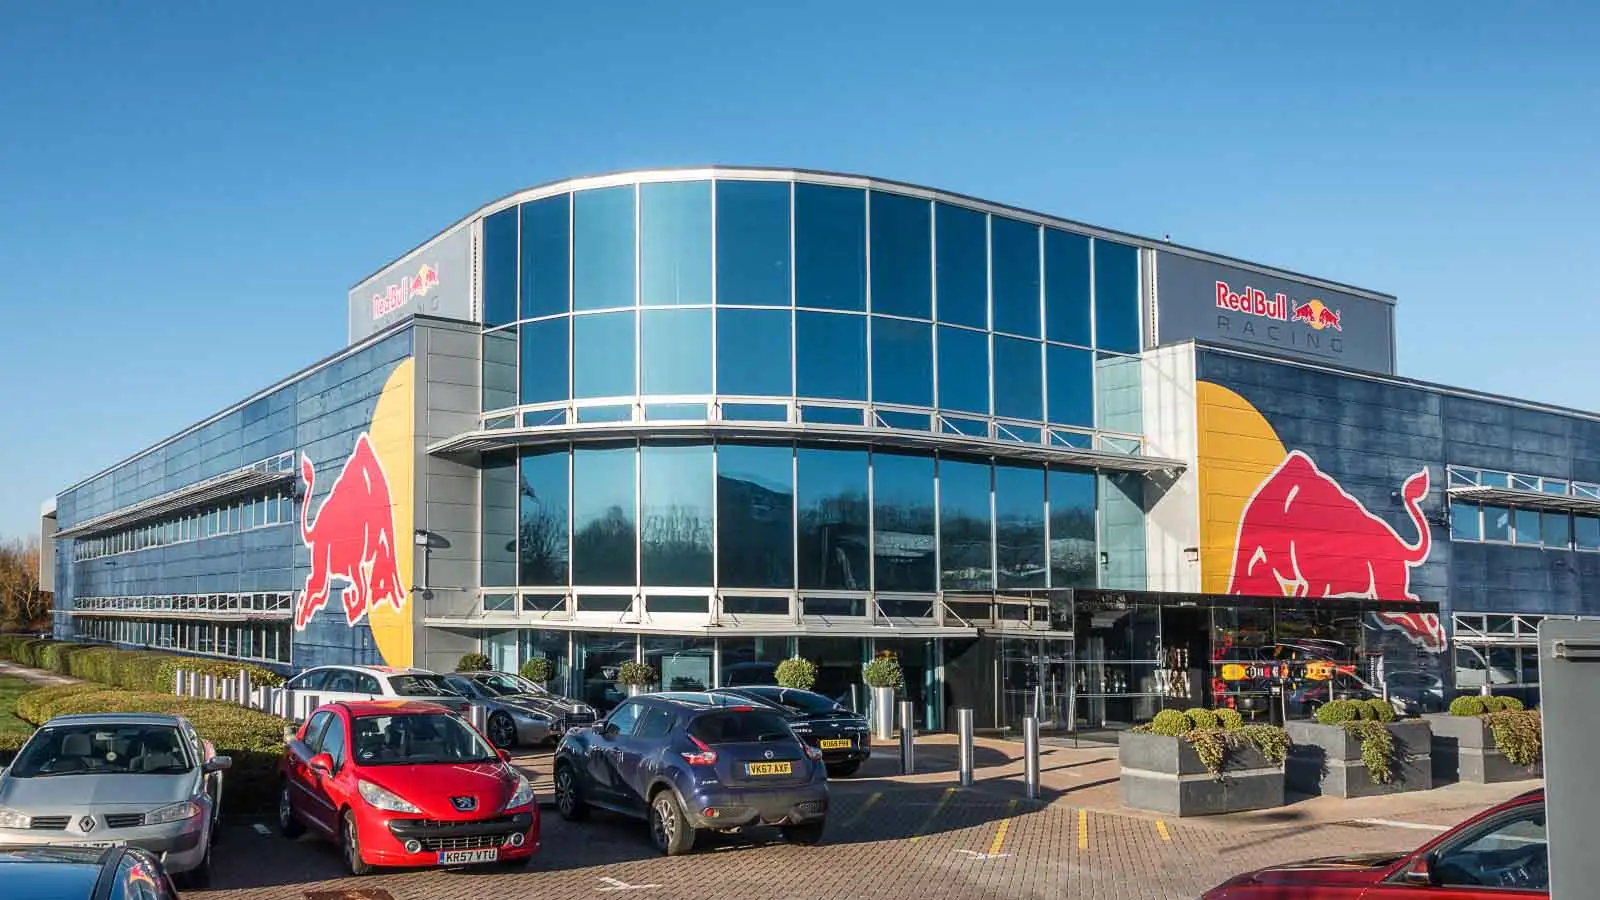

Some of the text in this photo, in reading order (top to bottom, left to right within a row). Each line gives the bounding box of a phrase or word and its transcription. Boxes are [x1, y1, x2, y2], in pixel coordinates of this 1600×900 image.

[1217, 315, 1343, 353] RACING
[750, 762, 789, 774] VK67 AXF
[446, 849, 496, 863] KR57 VTU
